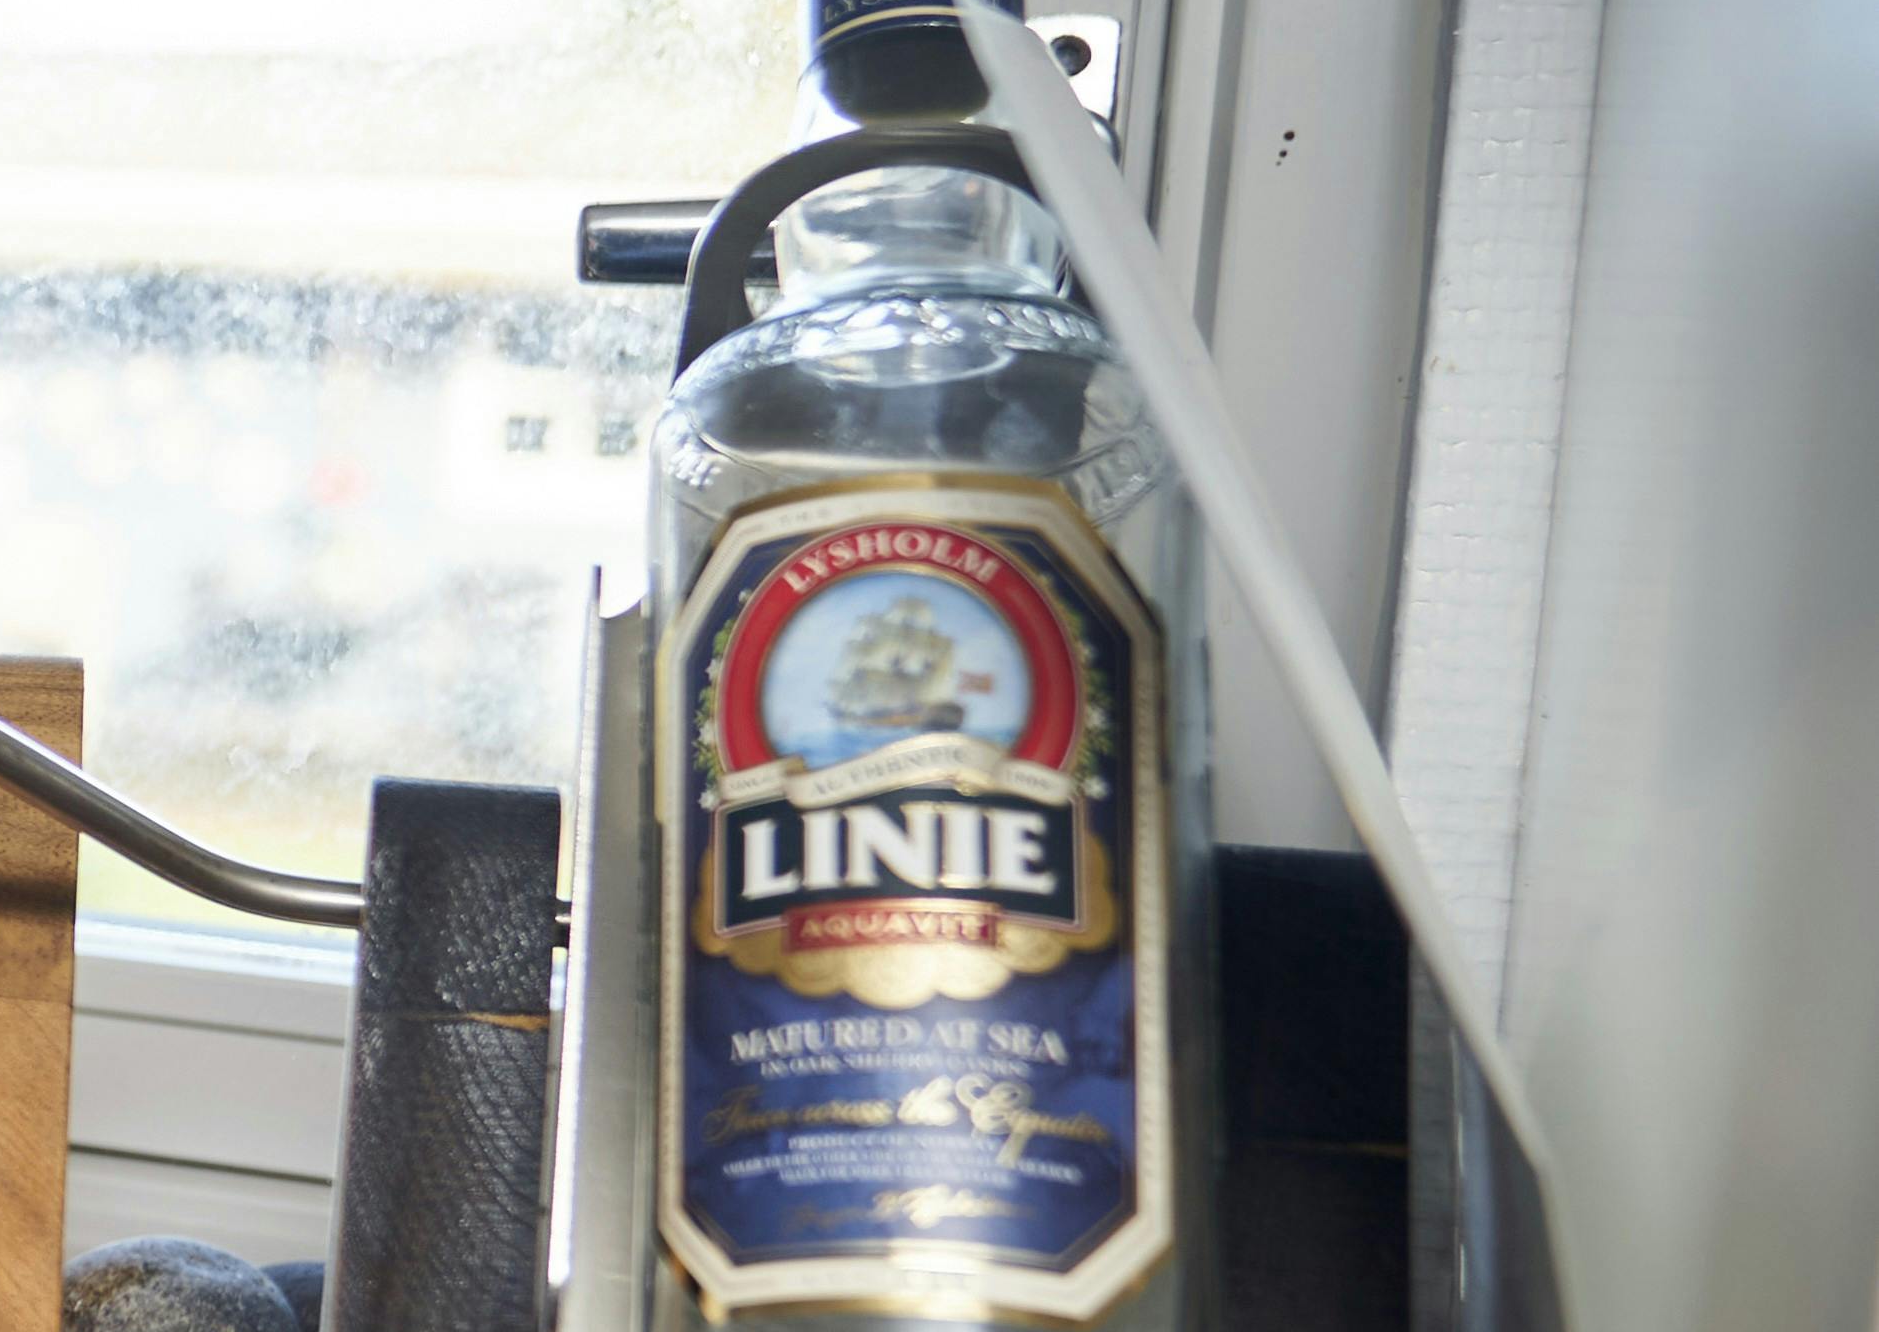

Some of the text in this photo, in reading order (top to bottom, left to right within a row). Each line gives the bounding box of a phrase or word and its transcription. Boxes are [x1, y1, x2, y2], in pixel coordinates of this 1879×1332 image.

[781, 528, 1001, 595] LYSHOLM
[741, 801, 1058, 901] LINIE
[799, 912, 982, 941] AQUAVIT
[730, 1016, 1069, 1066] MATURED AT SEA
